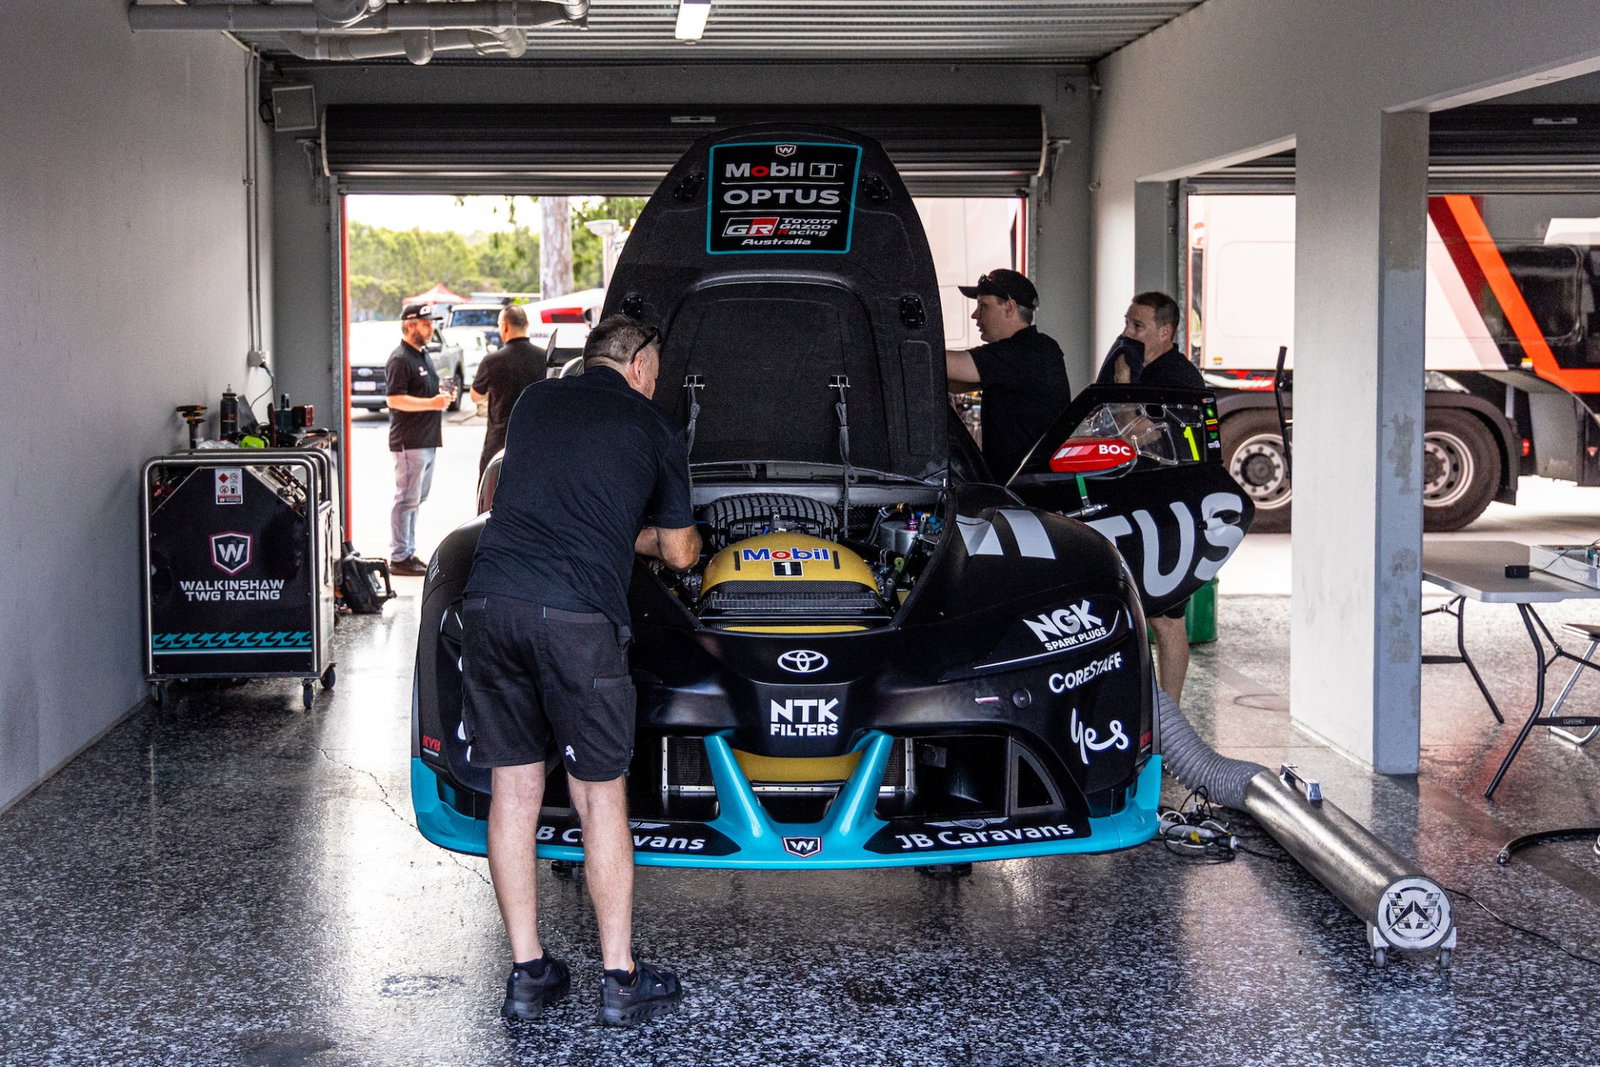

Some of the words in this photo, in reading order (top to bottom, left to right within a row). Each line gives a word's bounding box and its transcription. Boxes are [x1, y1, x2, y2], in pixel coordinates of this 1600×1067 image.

[725, 162, 804, 177] Mobil
[723, 189, 840, 205] OPTUS
[726, 225, 773, 235] GR
[1098, 444, 1131, 456] BOC
[741, 548, 830, 561] Mobil
[180, 579, 285, 591] WALKINSHAW
[185, 591, 221, 601] TWG
[225, 590, 281, 601] RACING
[1022, 600, 1102, 642] NGK
[1044, 635, 1077, 651] SPARK
[1077, 626, 1107, 643] PLUGS
[770, 698, 839, 723] NTK
[770, 724, 839, 736] FILTERS
[895, 833, 934, 849] JB
[938, 824, 1074, 845] Caravans
